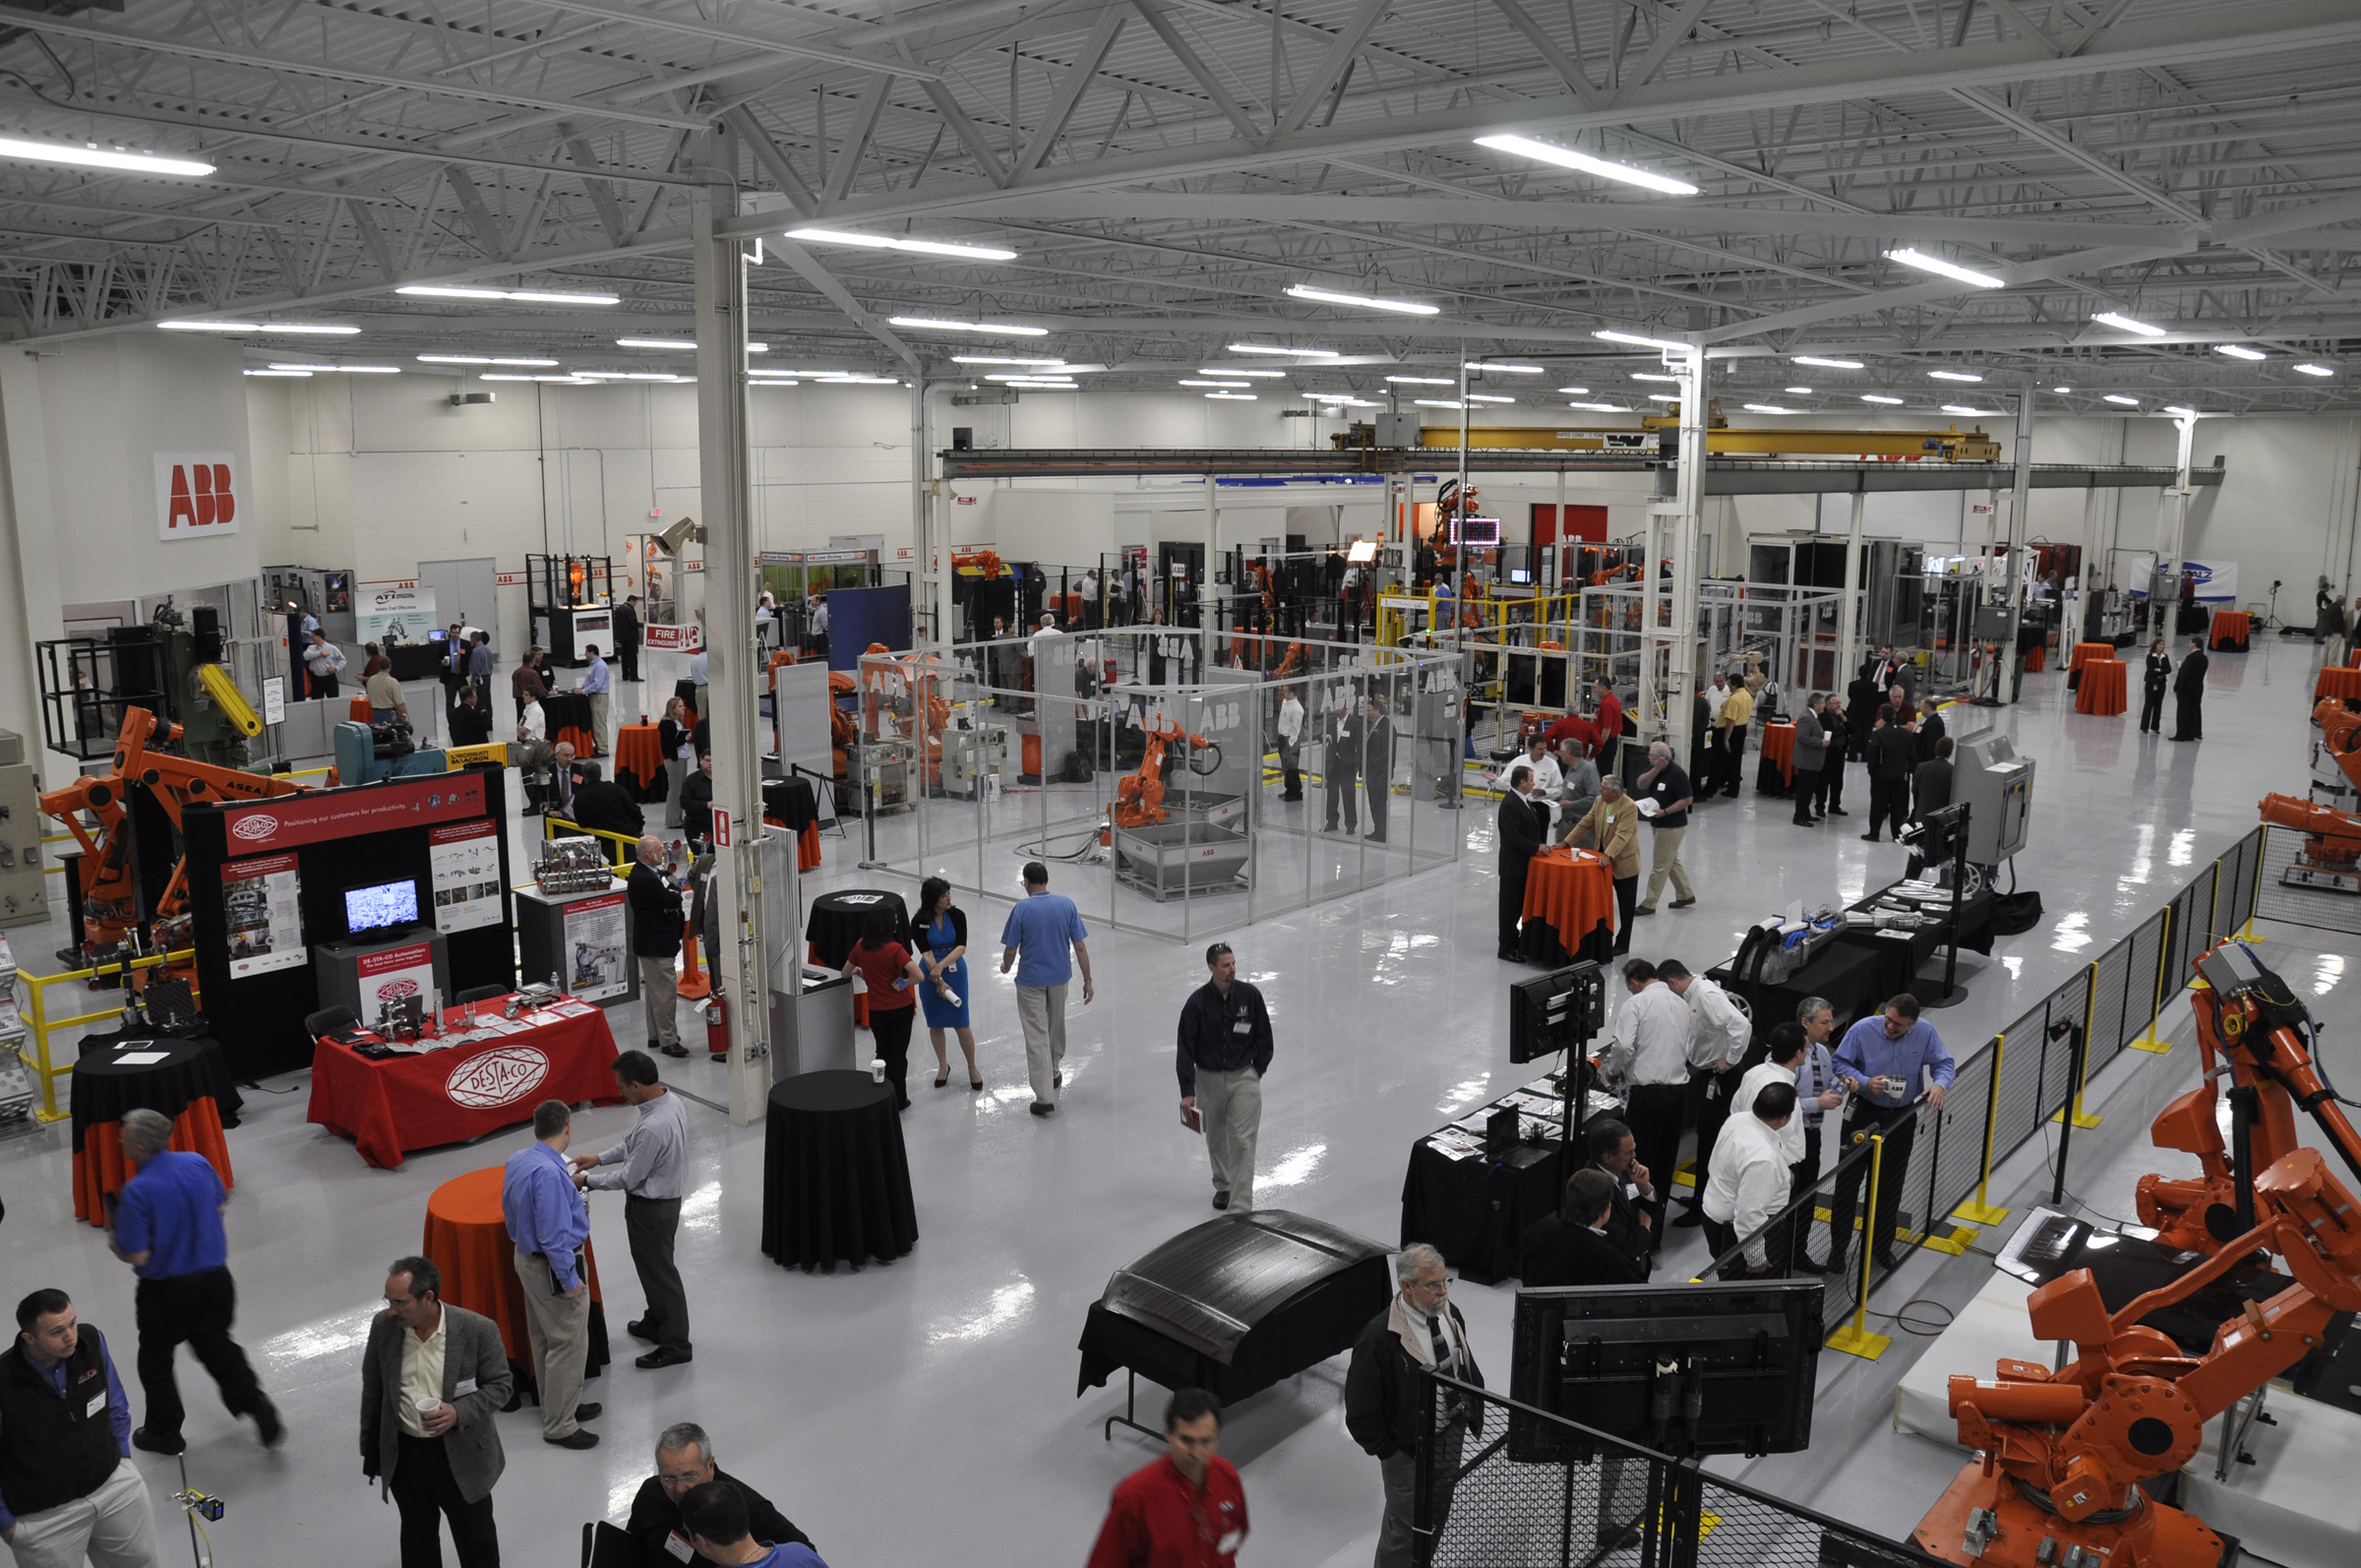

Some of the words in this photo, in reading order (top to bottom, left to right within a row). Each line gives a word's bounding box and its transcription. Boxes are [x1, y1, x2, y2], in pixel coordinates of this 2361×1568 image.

[168, 463, 235, 528] ABB
[655, 630, 676, 639] FIRE
[870, 670, 906, 698] ABB
[1424, 668, 1457, 694] ABB
[1320, 684, 1357, 714] ABB
[1125, 702, 1175, 734] ABB
[1198, 701, 1241, 734] ABB
[452, 751, 489, 759] CINCINNATI
[452, 755, 489, 764] MILACRON
[225, 781, 262, 794] ASEA
[283, 817, 318, 827] Positioning
[331, 810, 360, 819] customers
[371, 803, 407, 814] productivity.
[363, 954, 394, 965] DE-STA-CO
[394, 948, 426, 958] Automation
